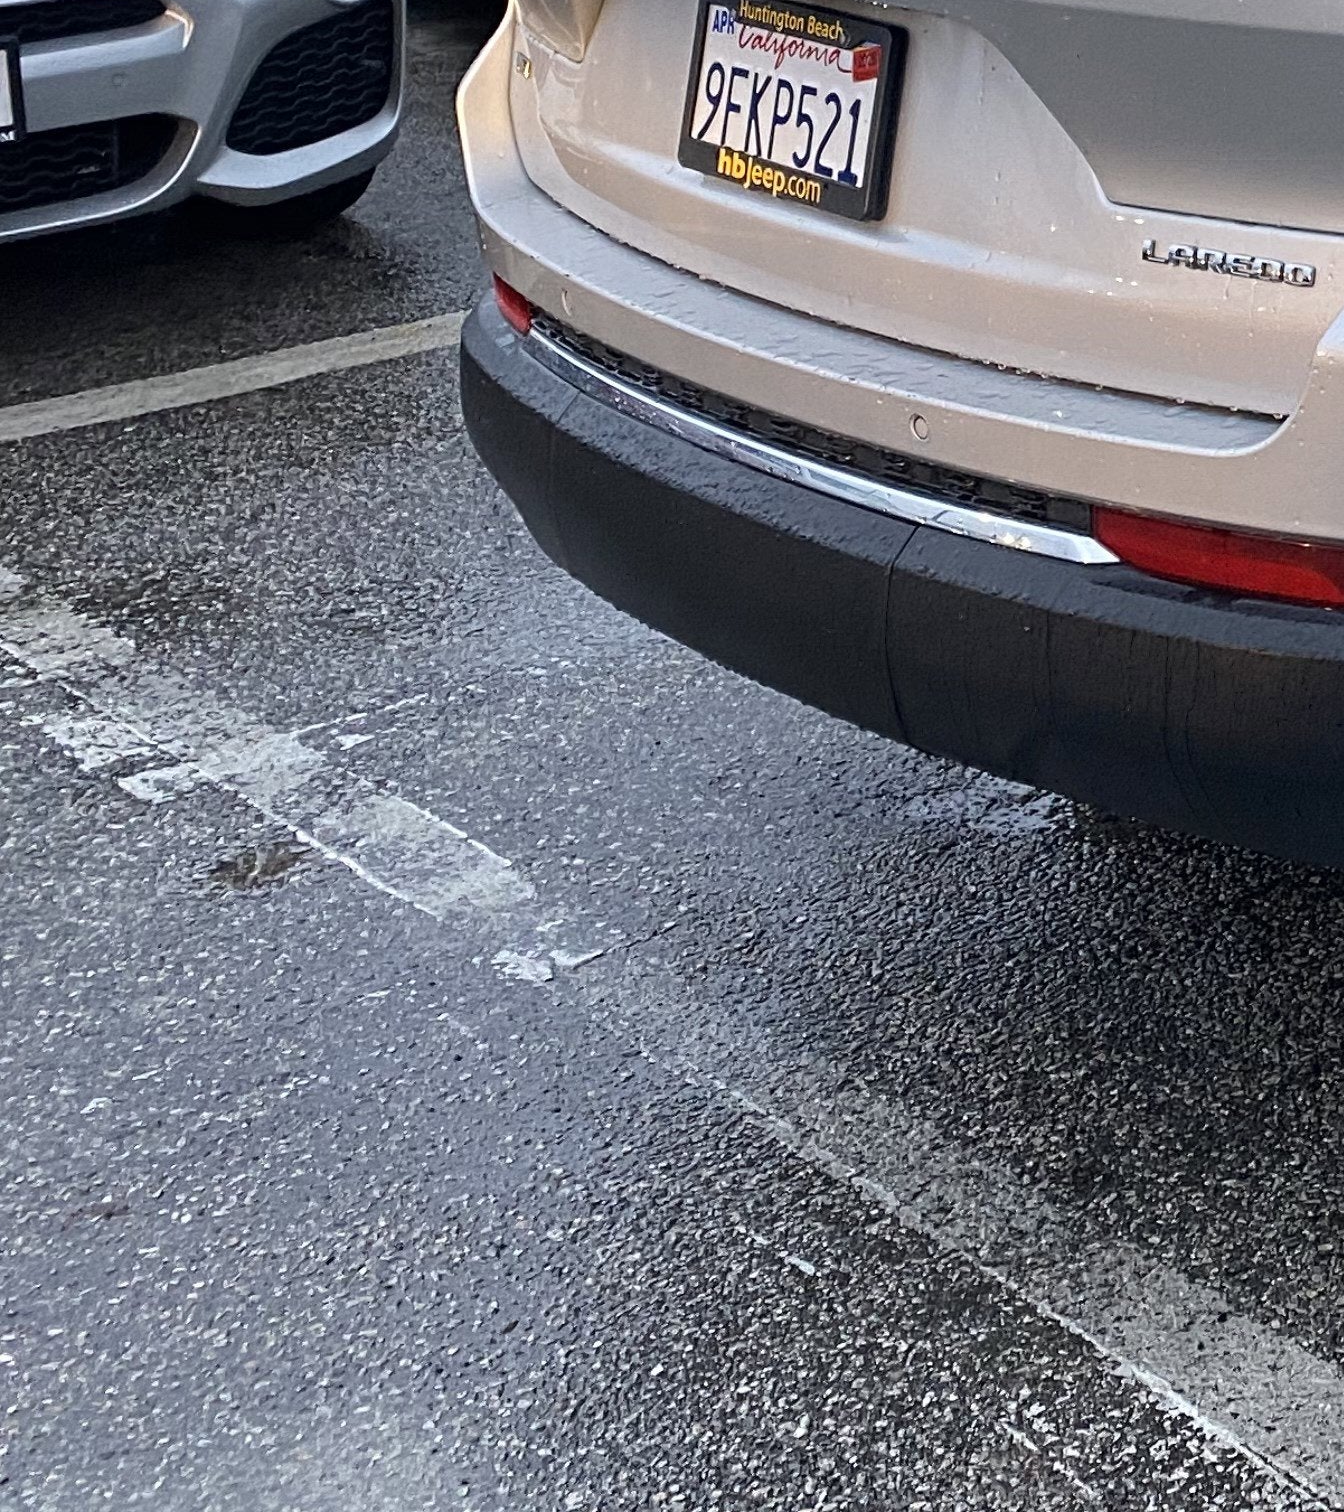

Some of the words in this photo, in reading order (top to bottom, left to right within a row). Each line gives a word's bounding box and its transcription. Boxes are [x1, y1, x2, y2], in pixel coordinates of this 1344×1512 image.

[739, 0, 807, 32] Huntington
[807, 15, 844, 41] Beach
[738, 24, 852, 70] California
[697, 61, 862, 186] 9FKP521
[1142, 239, 1316, 288] LAREDO
